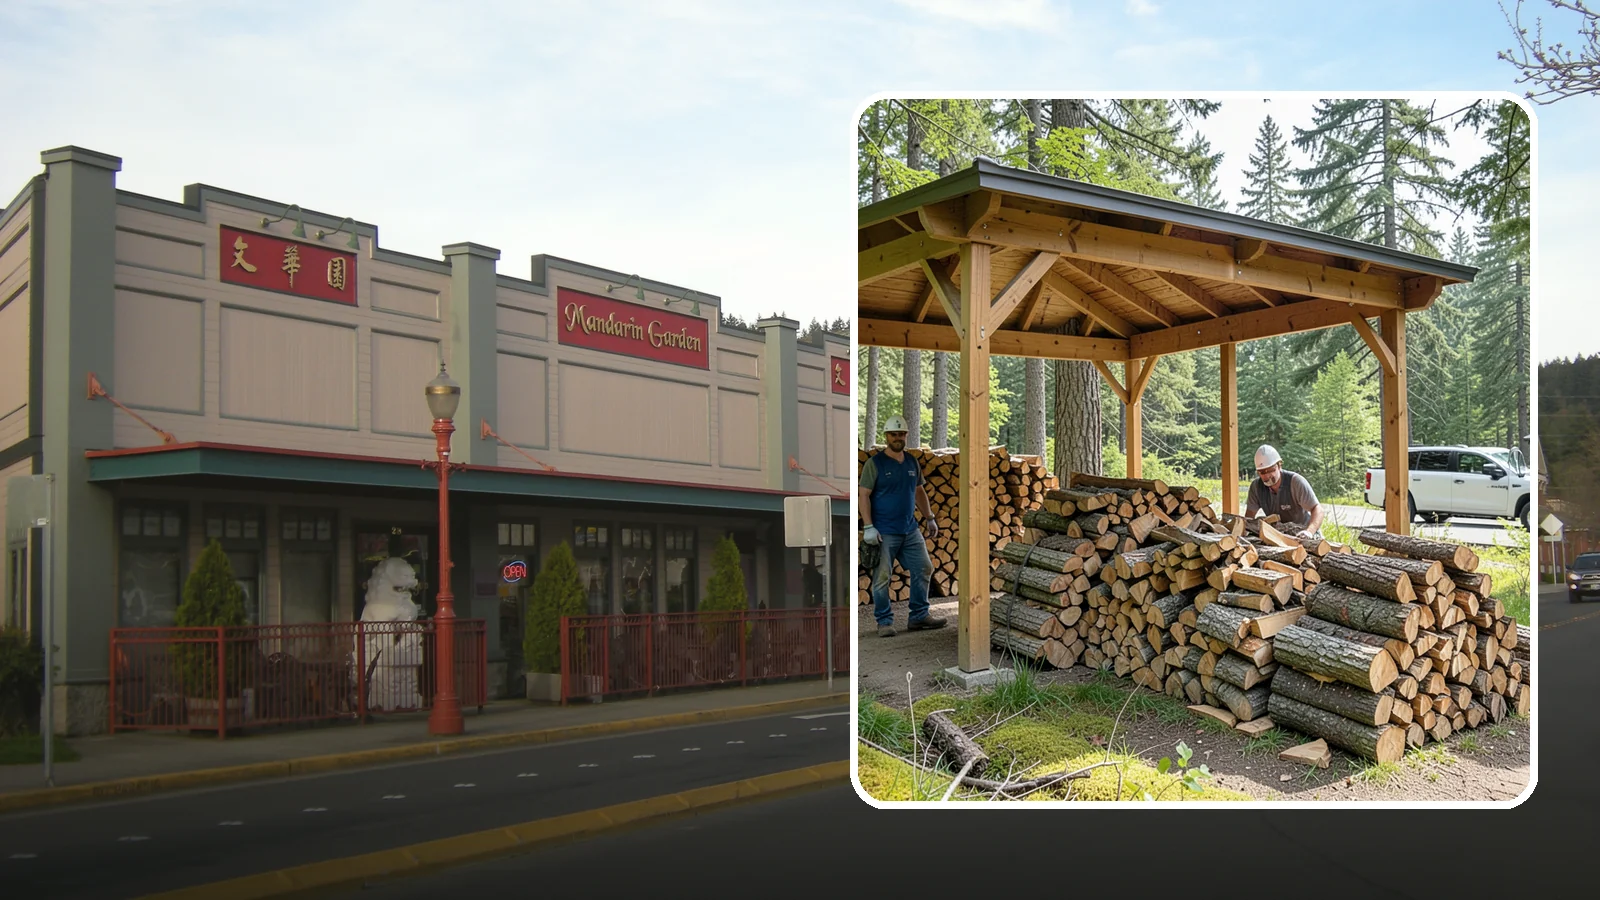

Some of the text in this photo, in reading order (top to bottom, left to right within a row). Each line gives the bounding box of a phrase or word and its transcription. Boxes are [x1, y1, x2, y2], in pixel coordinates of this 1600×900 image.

[230, 235, 346, 291] 文華園
[564, 302, 702, 352] Mandarin Garden
[835, 363, 846, 386] 文
[503, 565, 527, 578] OPEN
